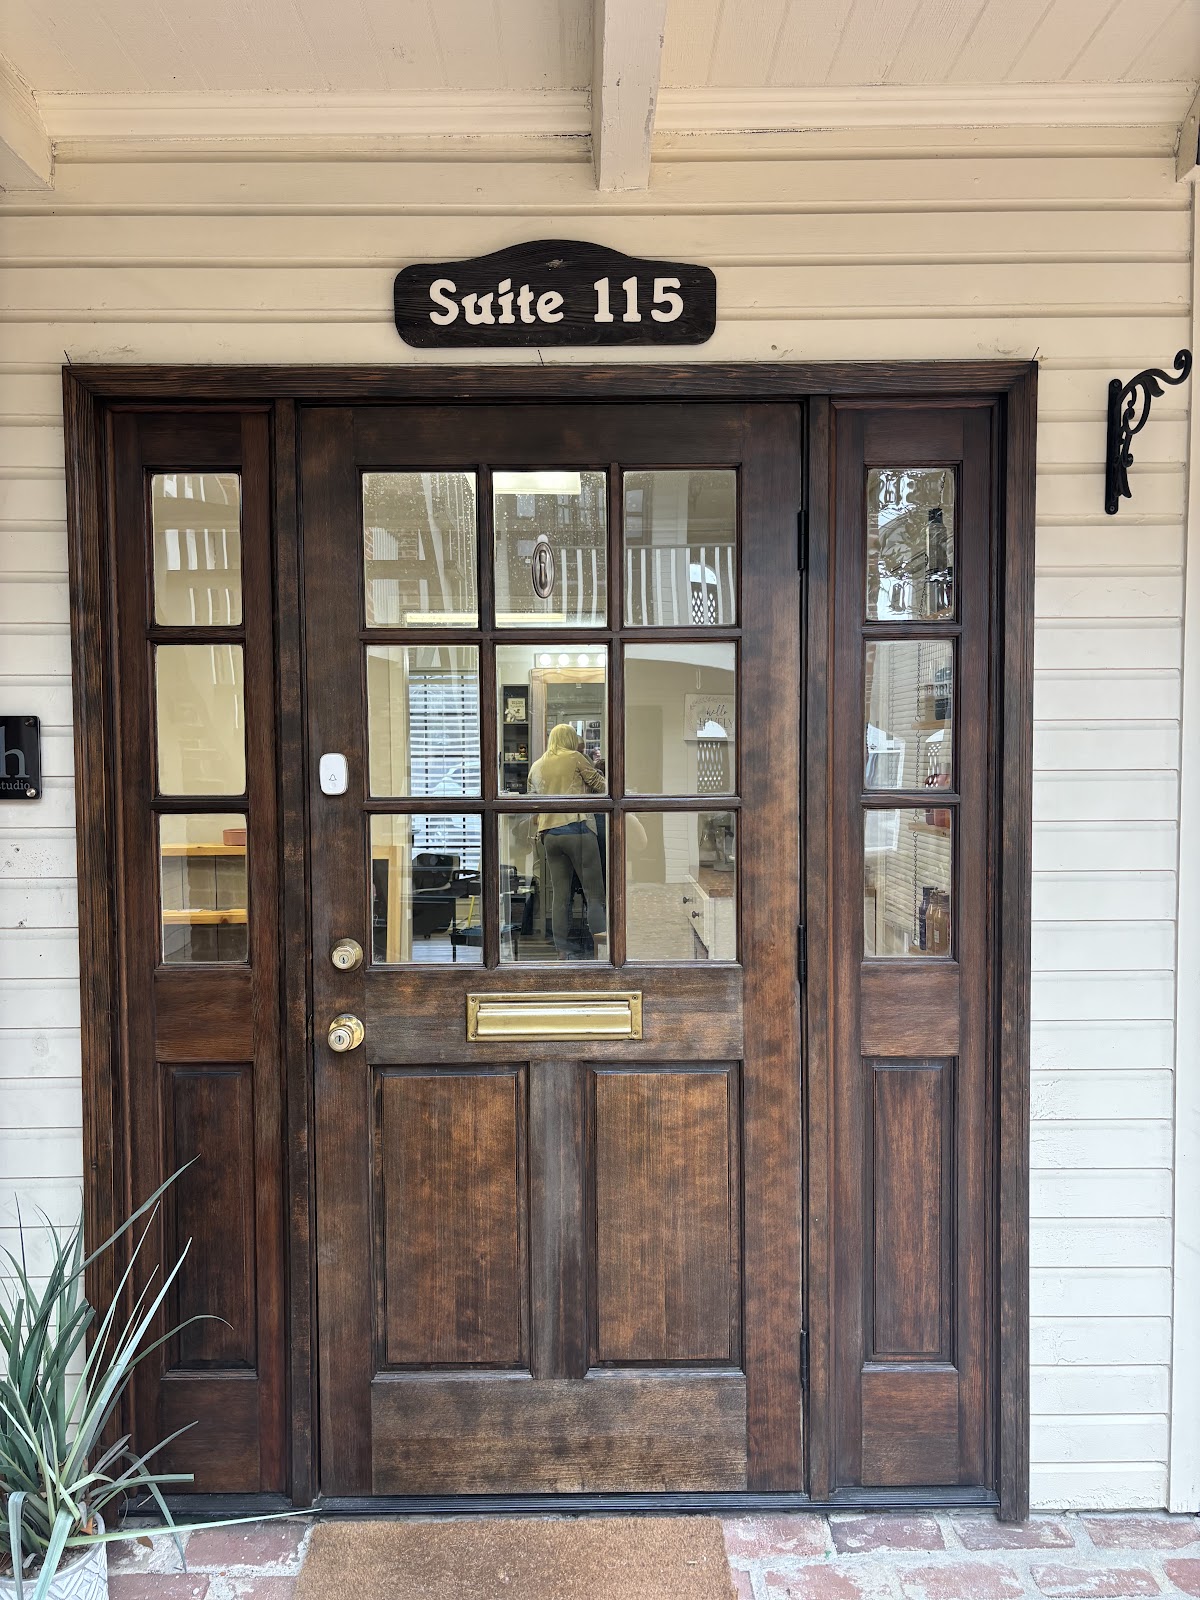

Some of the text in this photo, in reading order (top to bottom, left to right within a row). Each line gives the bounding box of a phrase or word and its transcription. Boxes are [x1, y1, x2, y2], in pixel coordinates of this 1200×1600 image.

[429, 276, 684, 326] Suite 115
[706, 704, 728, 717] hello
[700, 717, 733, 729] LELY
[0, 780, 31, 790] tudio
